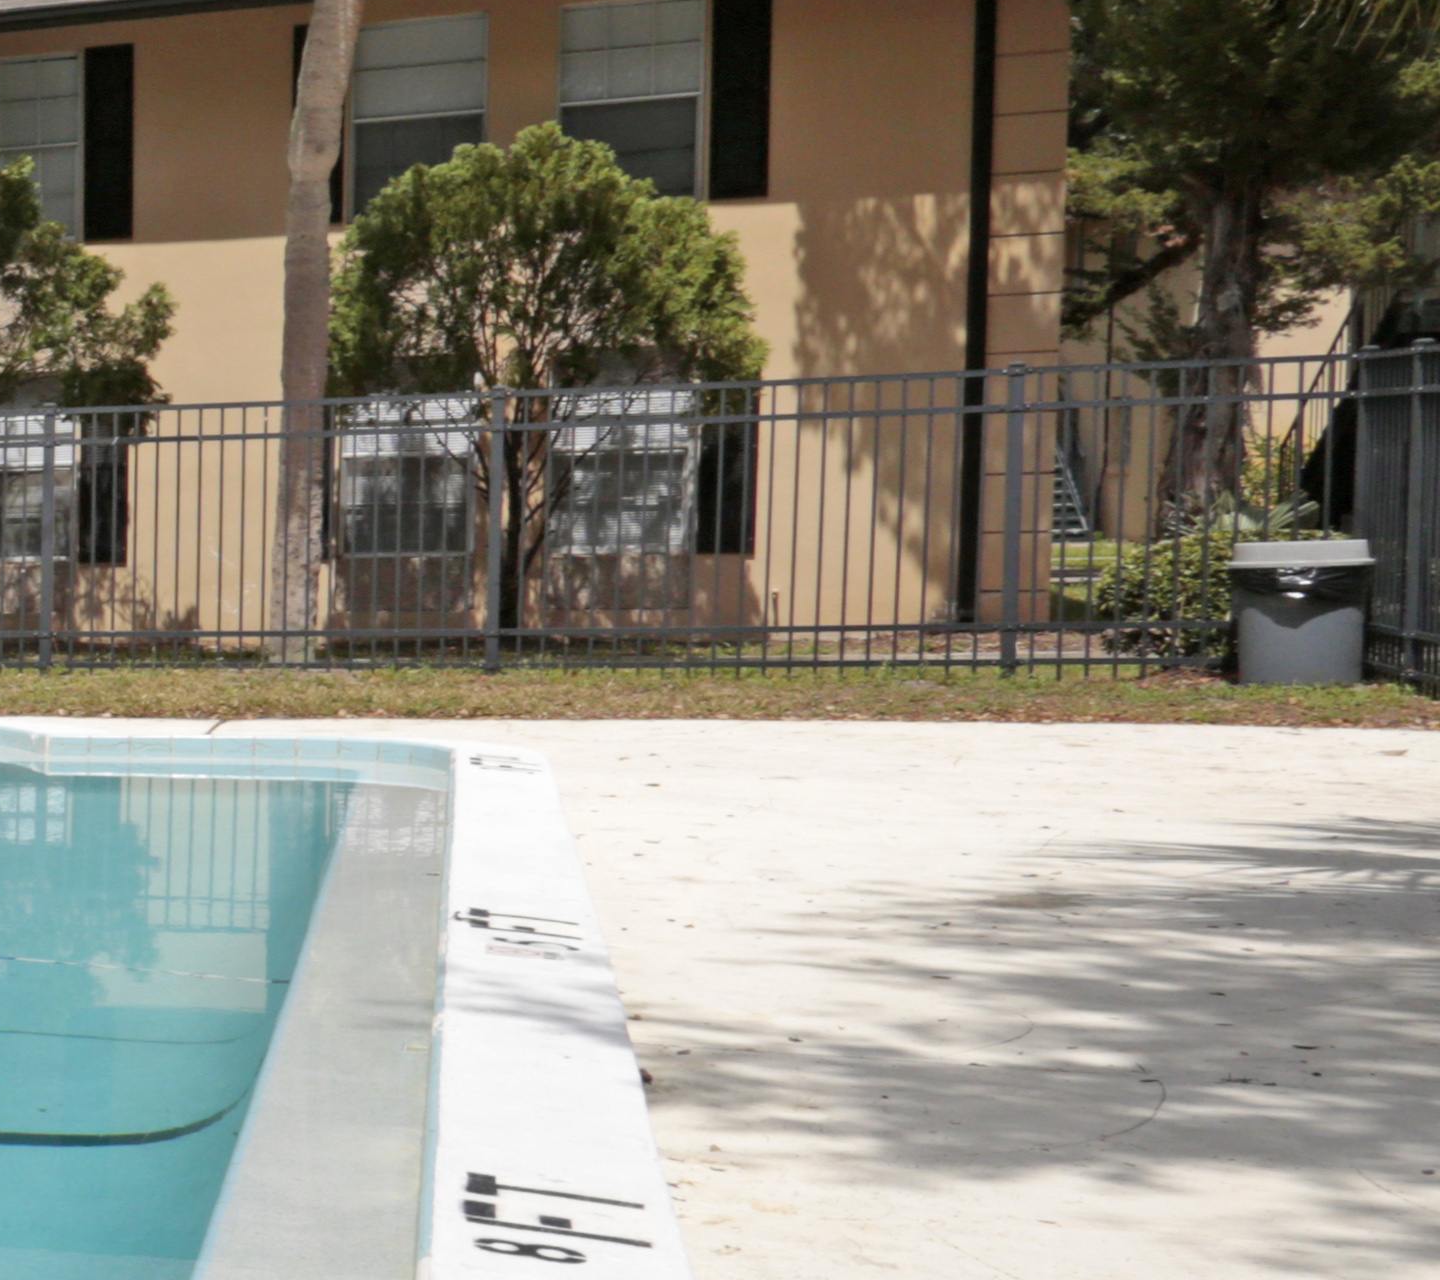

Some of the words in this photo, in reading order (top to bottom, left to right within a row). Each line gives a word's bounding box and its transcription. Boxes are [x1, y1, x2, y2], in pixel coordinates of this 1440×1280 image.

[467, 907, 583, 940] FT
[462, 1171, 653, 1249] FT
[473, 1238, 587, 1265] 8
